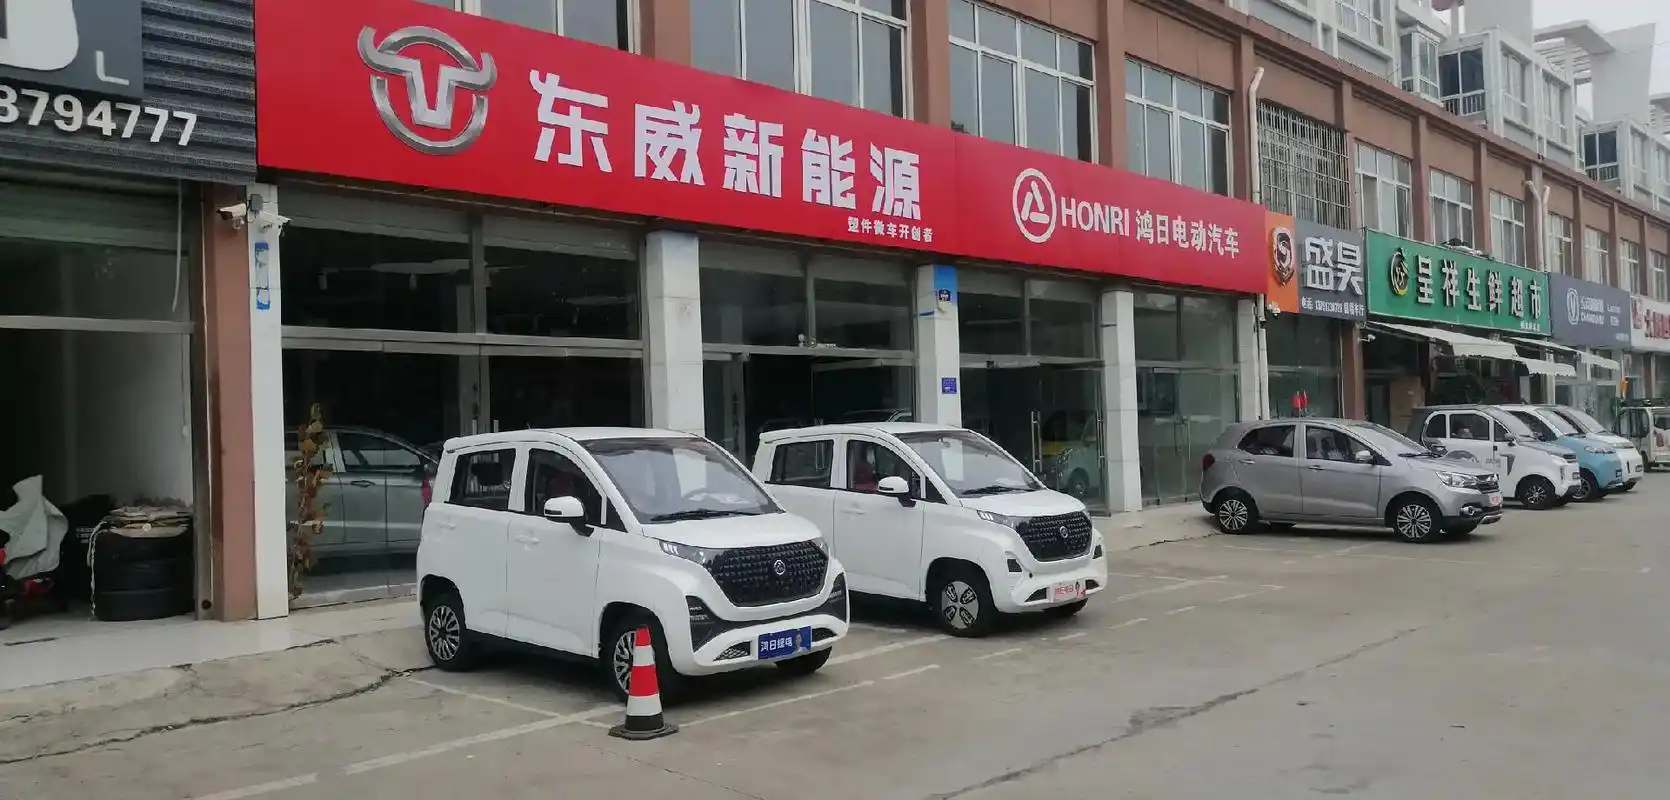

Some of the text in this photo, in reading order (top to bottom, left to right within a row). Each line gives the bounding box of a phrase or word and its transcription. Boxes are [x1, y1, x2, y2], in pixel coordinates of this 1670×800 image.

[529, 69, 922, 221] 东威新能源
[1060, 196, 1241, 259] HONRI 鸿日电动汽车
[1304, 236, 1364, 296] 盛昊
[1417, 254, 1542, 320] 呈祥生鲜超市
